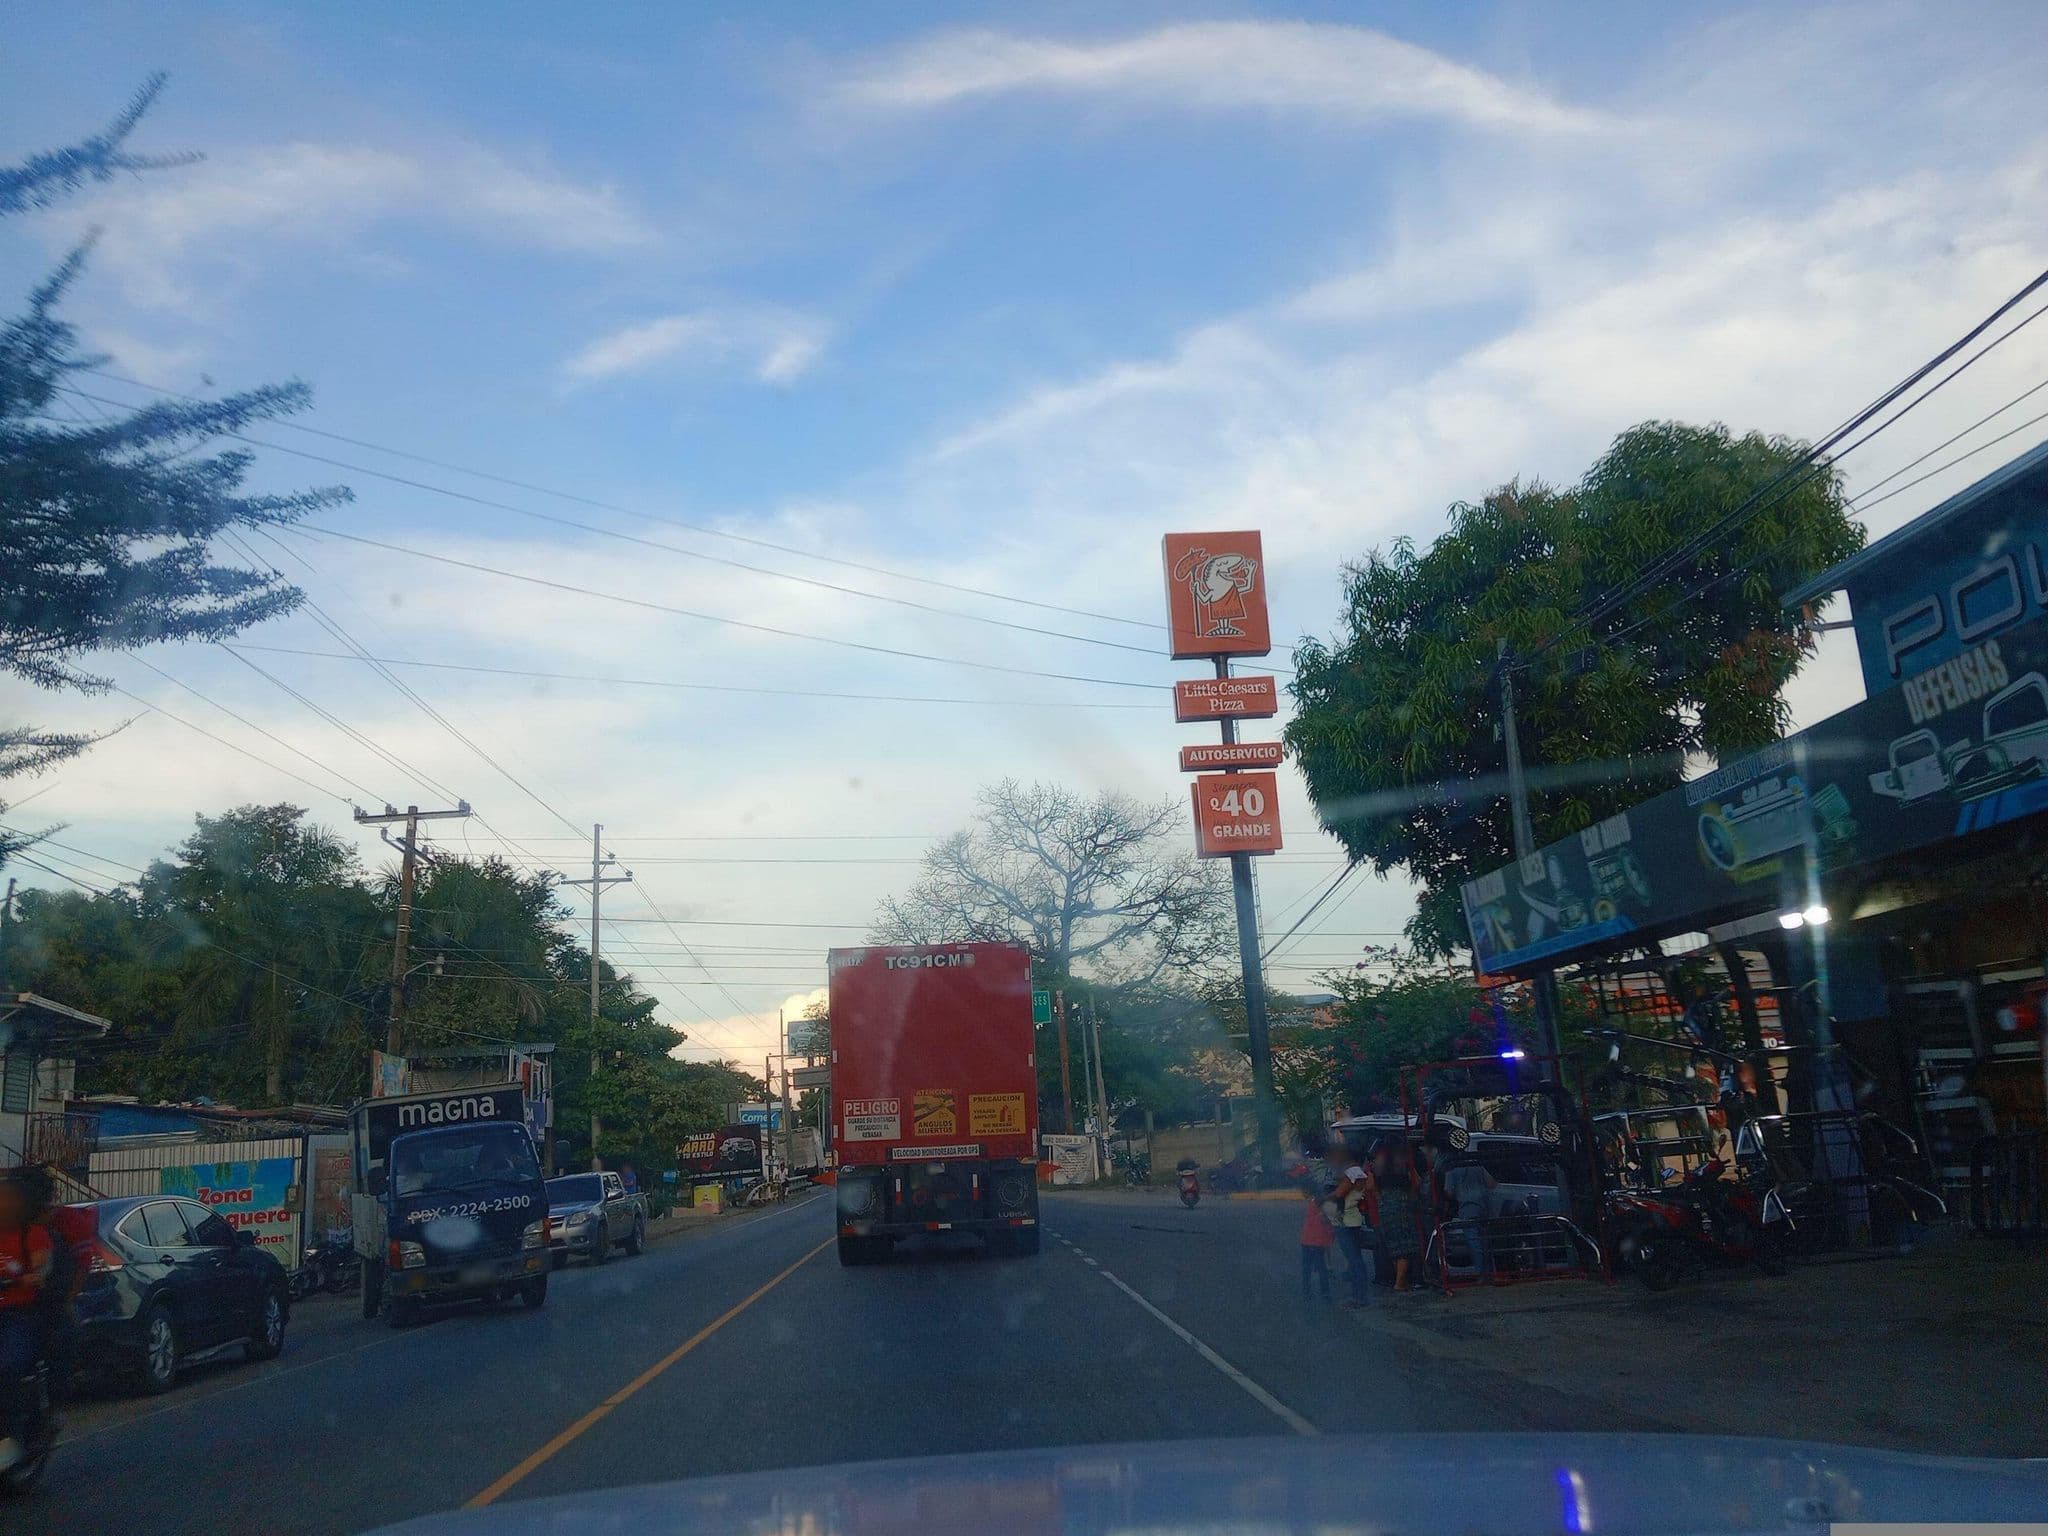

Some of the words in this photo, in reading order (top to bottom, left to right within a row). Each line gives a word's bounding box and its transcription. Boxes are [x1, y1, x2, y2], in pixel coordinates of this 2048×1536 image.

[1902, 640, 2010, 724] DEFENSAS
[1184, 683, 1217, 697] Little
[1218, 682, 1268, 696] Caesars
[1209, 698, 1246, 712] Pizza
[1189, 747, 1277, 761] AUTOSERVICIO
[1212, 824, 1271, 838] GRANDE
[845, 1101, 898, 1115] PELIGRO
[918, 1120, 952, 1128] ANGULOS
[918, 1126, 952, 1134] MUERTOS
[684, 1132, 715, 1141] NALIZA
[197, 1186, 253, 1206] Zona
[449, 1195, 530, 1218] 2224-2500
